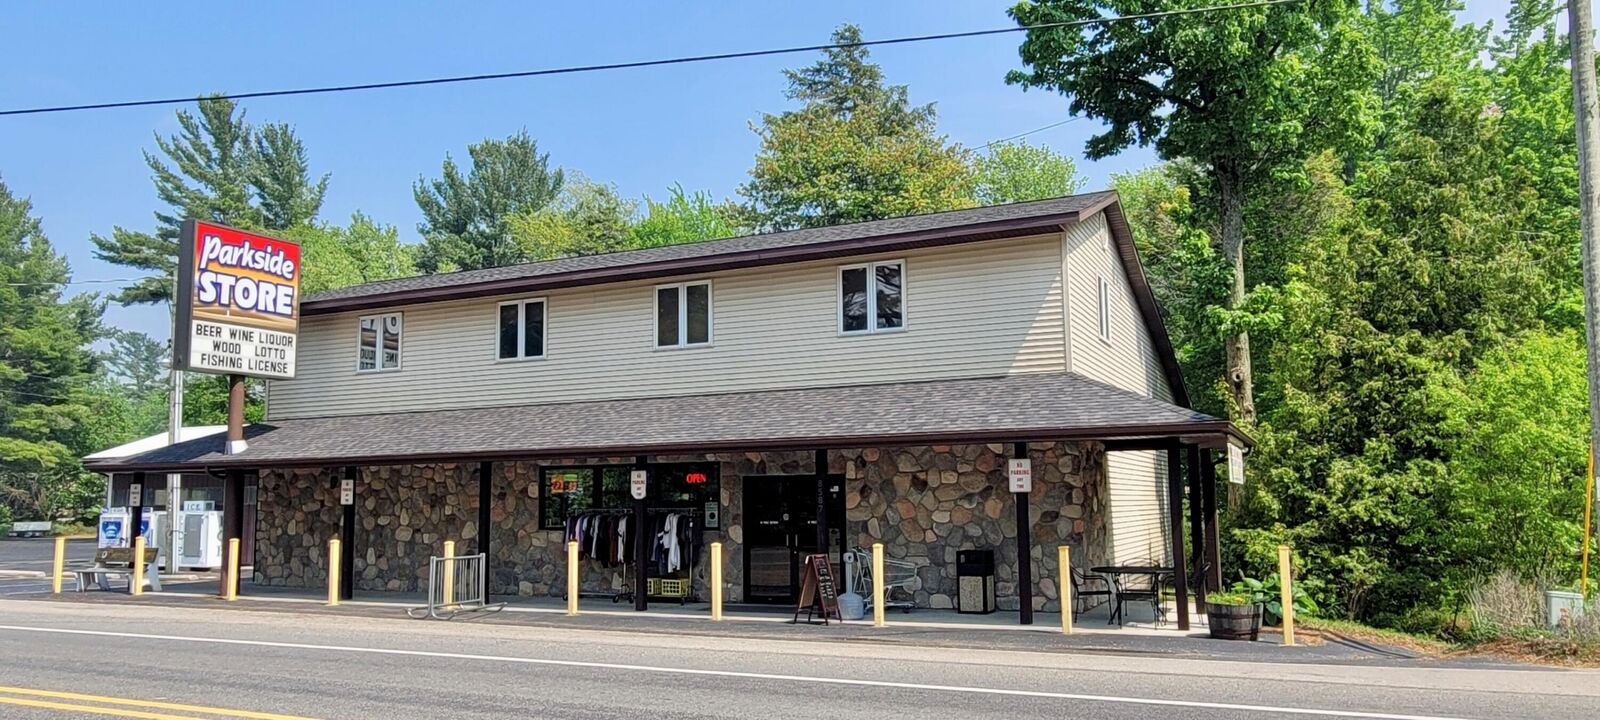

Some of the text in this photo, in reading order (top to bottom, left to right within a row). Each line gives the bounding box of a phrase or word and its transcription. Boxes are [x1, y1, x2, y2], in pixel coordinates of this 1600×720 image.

[199, 234, 295, 280] Parkside
[198, 271, 295, 316] STORE
[196, 323, 293, 347] BEER WINE LIQUOR
[213, 340, 286, 360] WOOD LOTTO
[201, 353, 288, 373] FISHING LICENSE
[686, 473, 706, 483] OPEN
[187, 503, 200, 511] ICE
